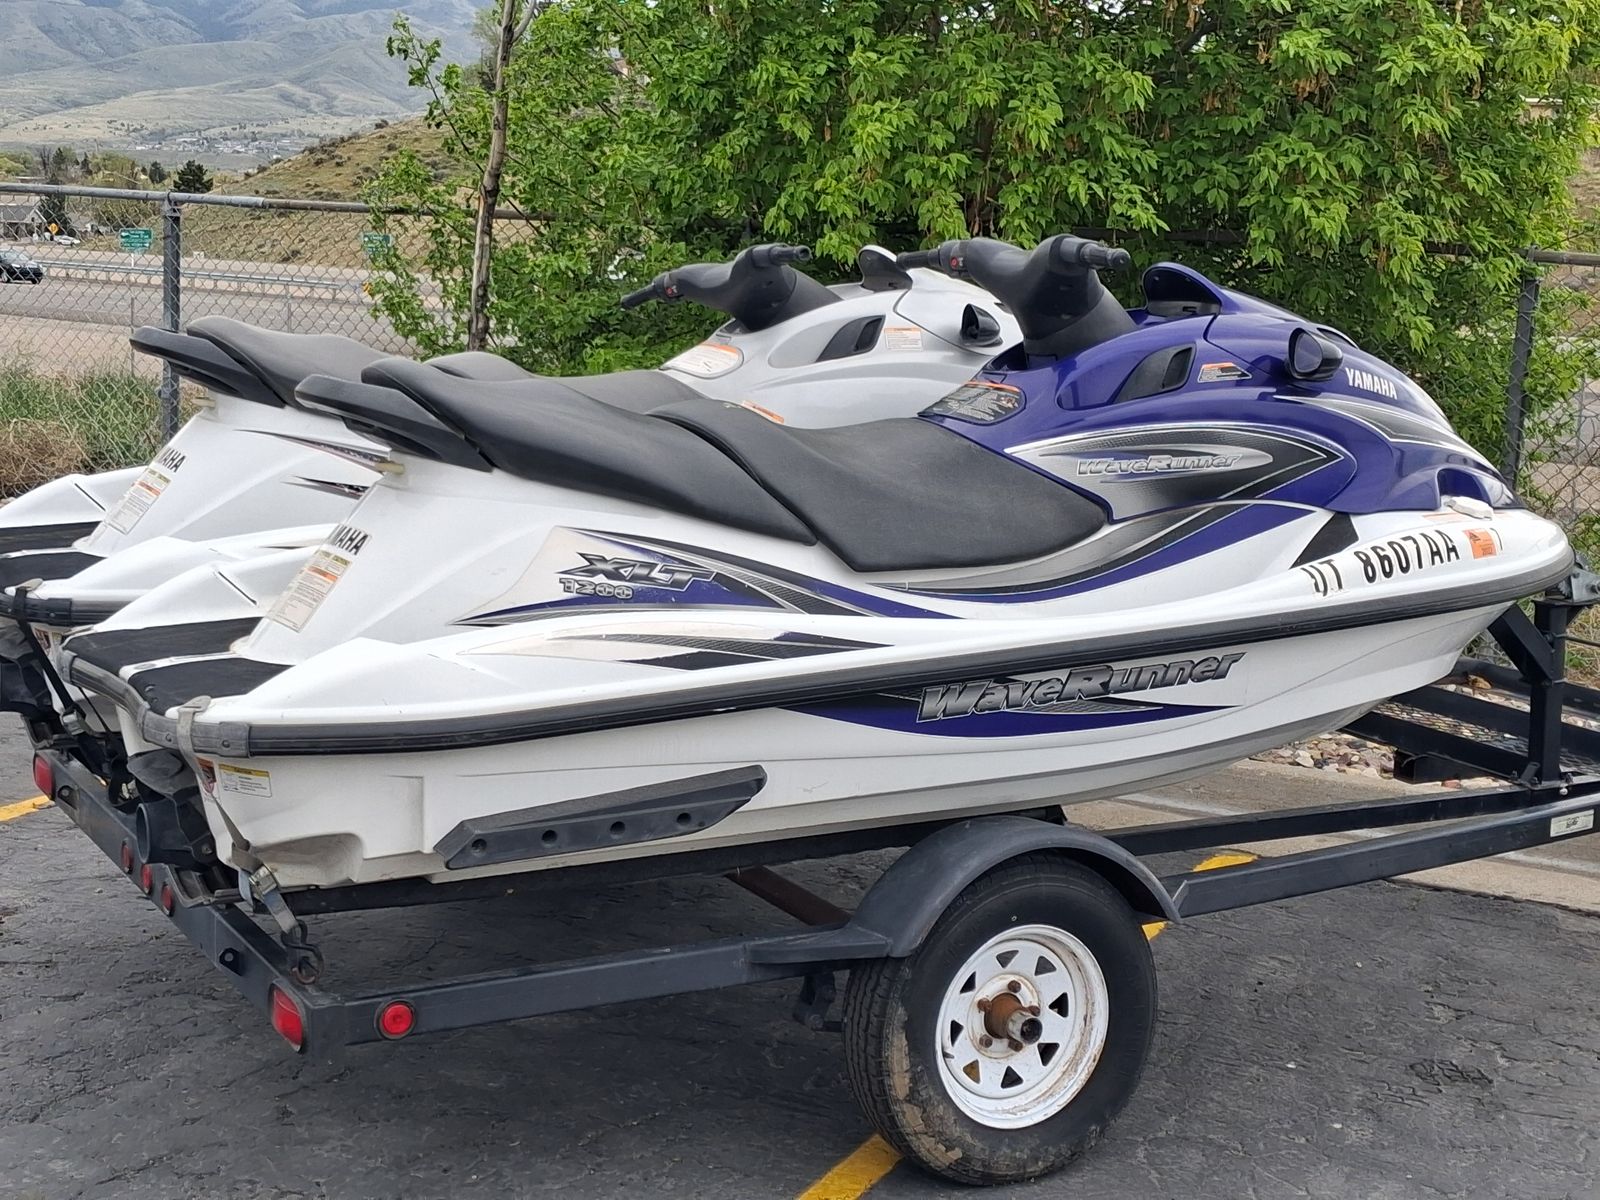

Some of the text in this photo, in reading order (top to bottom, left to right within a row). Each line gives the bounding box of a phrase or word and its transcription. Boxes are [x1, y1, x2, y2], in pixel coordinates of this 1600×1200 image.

[1345, 366, 1398, 400] YAMAHA
[1077, 454, 1243, 477] WaveRunner
[555, 552, 717, 592] XLT
[1354, 529, 1460, 584] 8607AA
[559, 578, 634, 599] 1200
[916, 651, 1247, 723] WaveRunner
